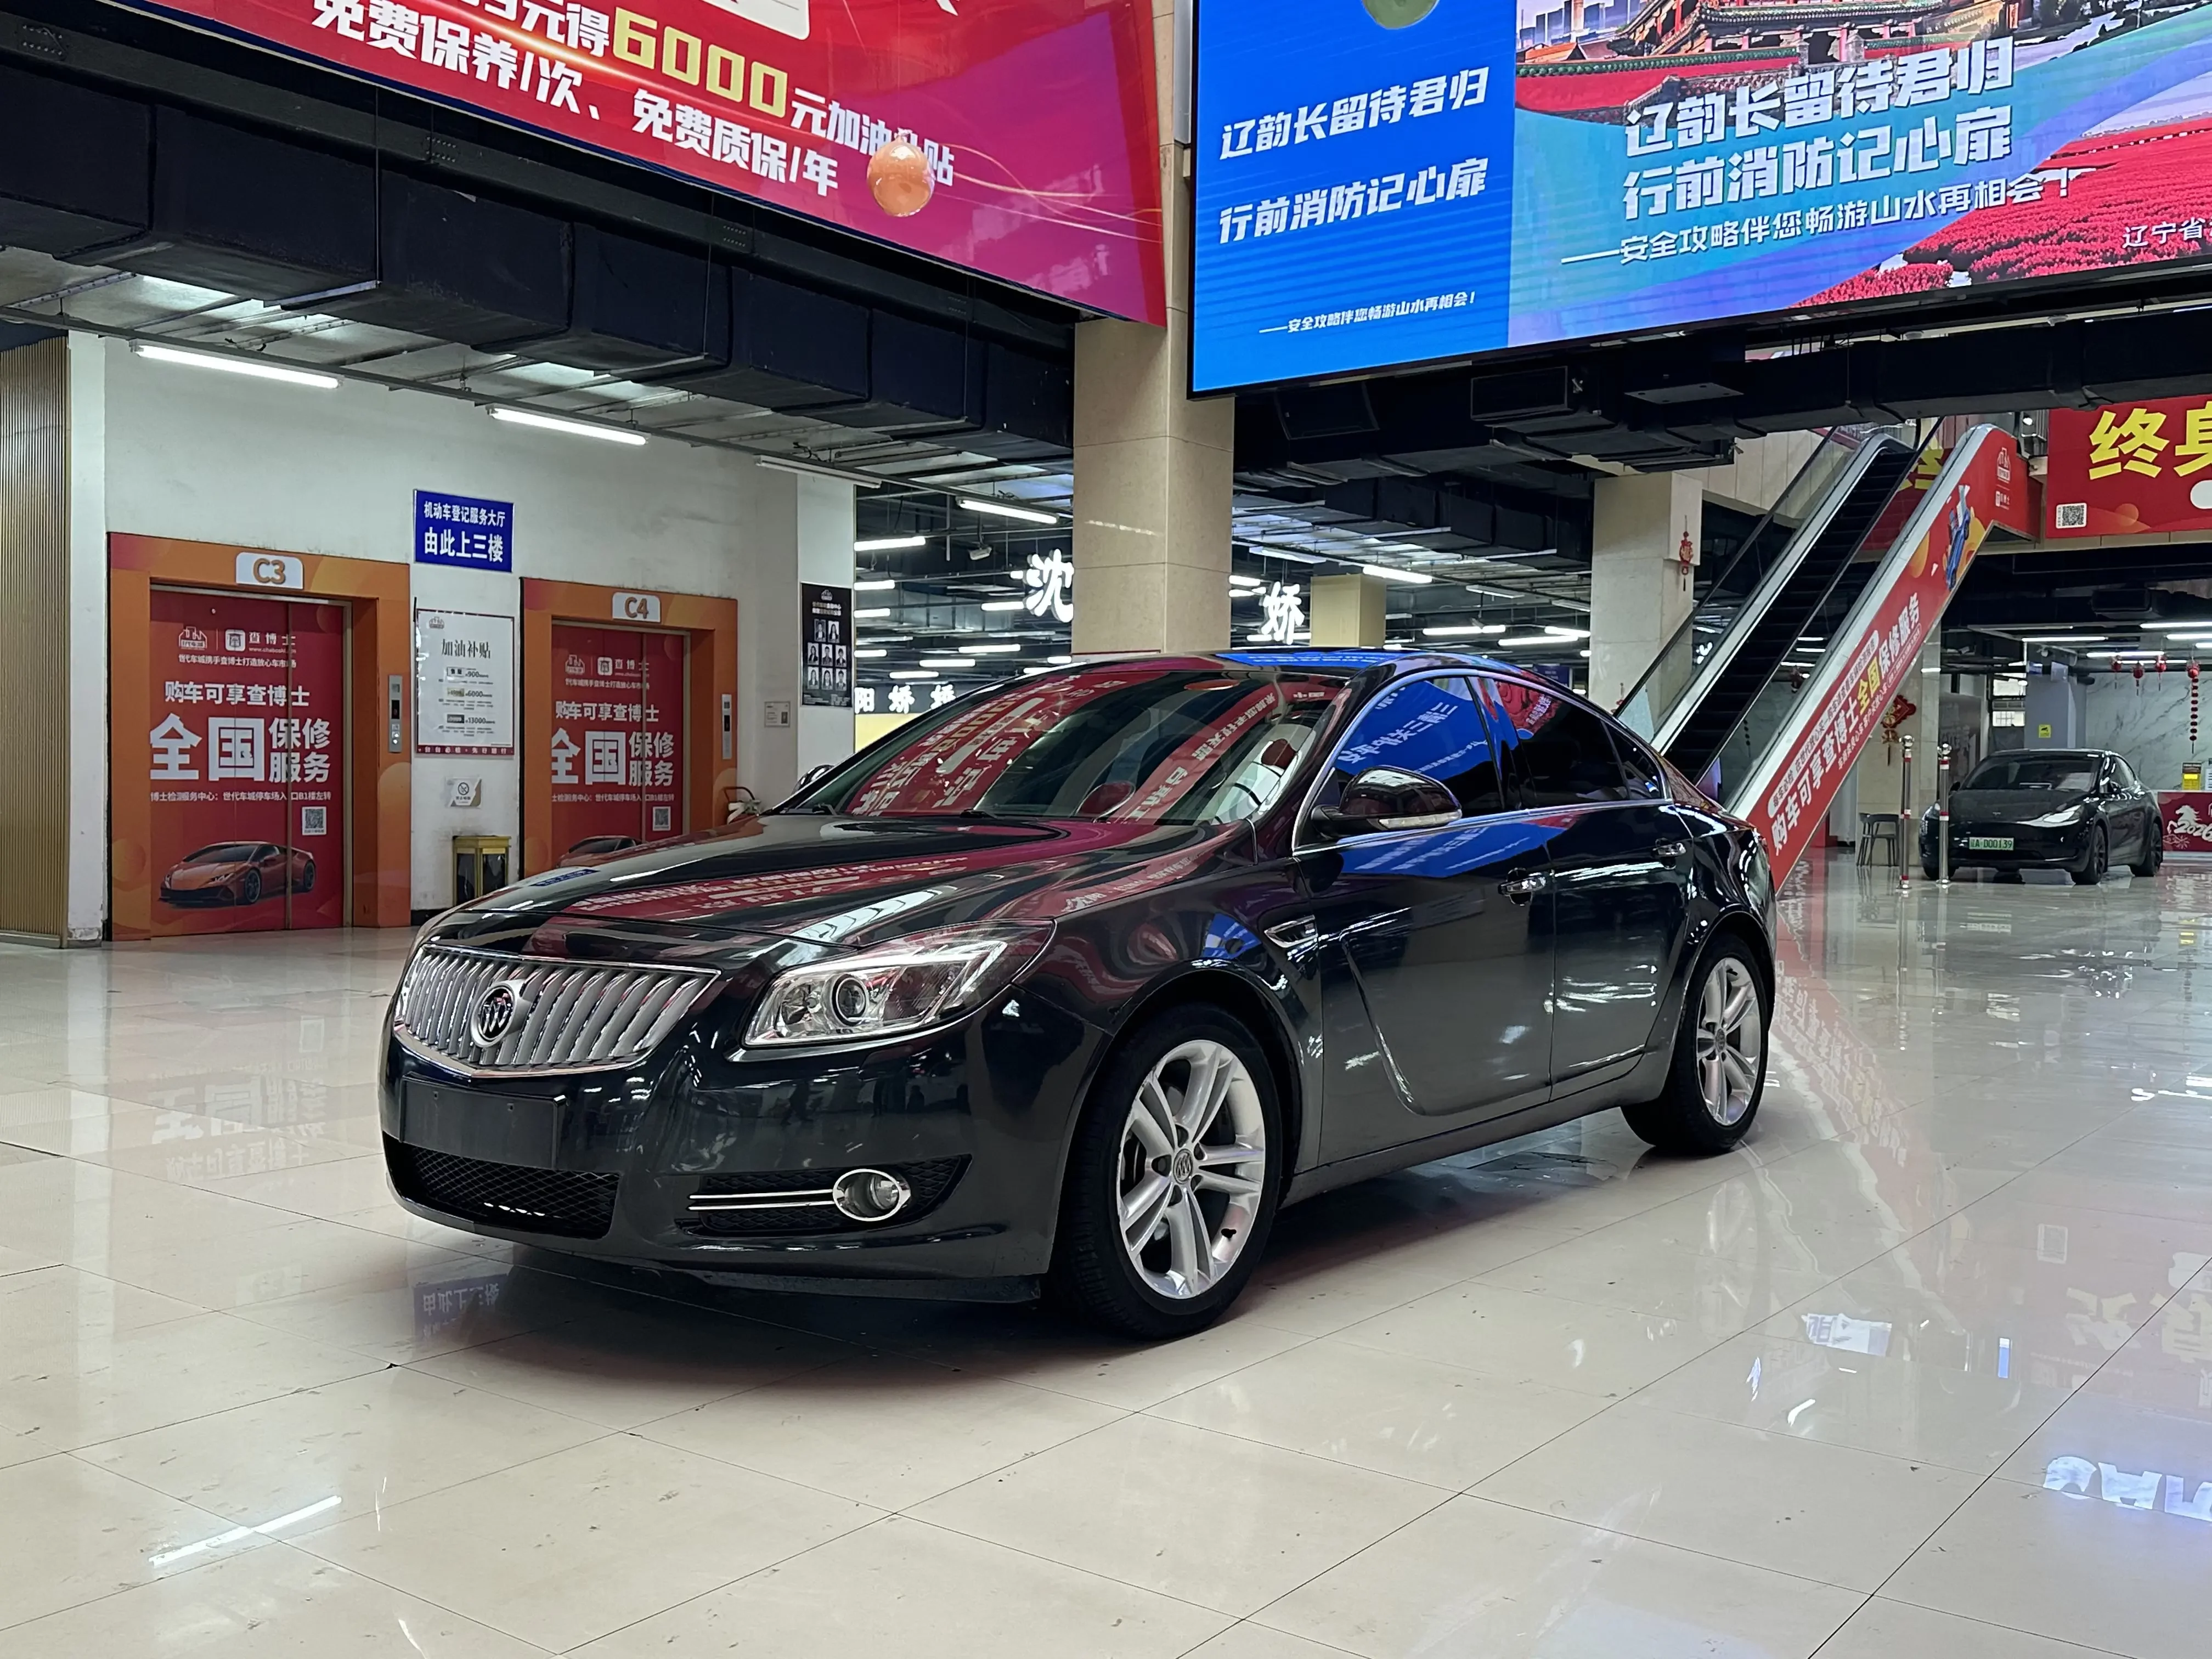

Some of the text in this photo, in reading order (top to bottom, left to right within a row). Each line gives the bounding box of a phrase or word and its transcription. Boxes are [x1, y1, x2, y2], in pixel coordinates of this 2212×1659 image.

[1220, 67, 1489, 160] 辽韵长留待君归
[1624, 36, 2015, 159] 辽韵长留待君归
[1621, 105, 2013, 221] 行前消防记心扉
[1220, 157, 1489, 244] 行前消防记心扉
[2121, 216, 2212, 249] 辽宁省
[424, 501, 505, 528] 机动车登记服务大厅
[424, 527, 503, 563] 由此上三楼
[253, 558, 286, 584] C3
[1024, 549, 1074, 623] 沈
[625, 596, 649, 619] C4
[441, 638, 492, 659] 加油补贴
[165, 680, 310, 707] 购车可享查博士
[556, 701, 659, 723] 购车可享查博士
[150, 713, 265, 782] 全国
[269, 718, 330, 750] 保修
[629, 731, 674, 758] 保修
[269, 752, 330, 783] 服务
[551, 727, 627, 786] 全国
[629, 760, 674, 786] 服务
